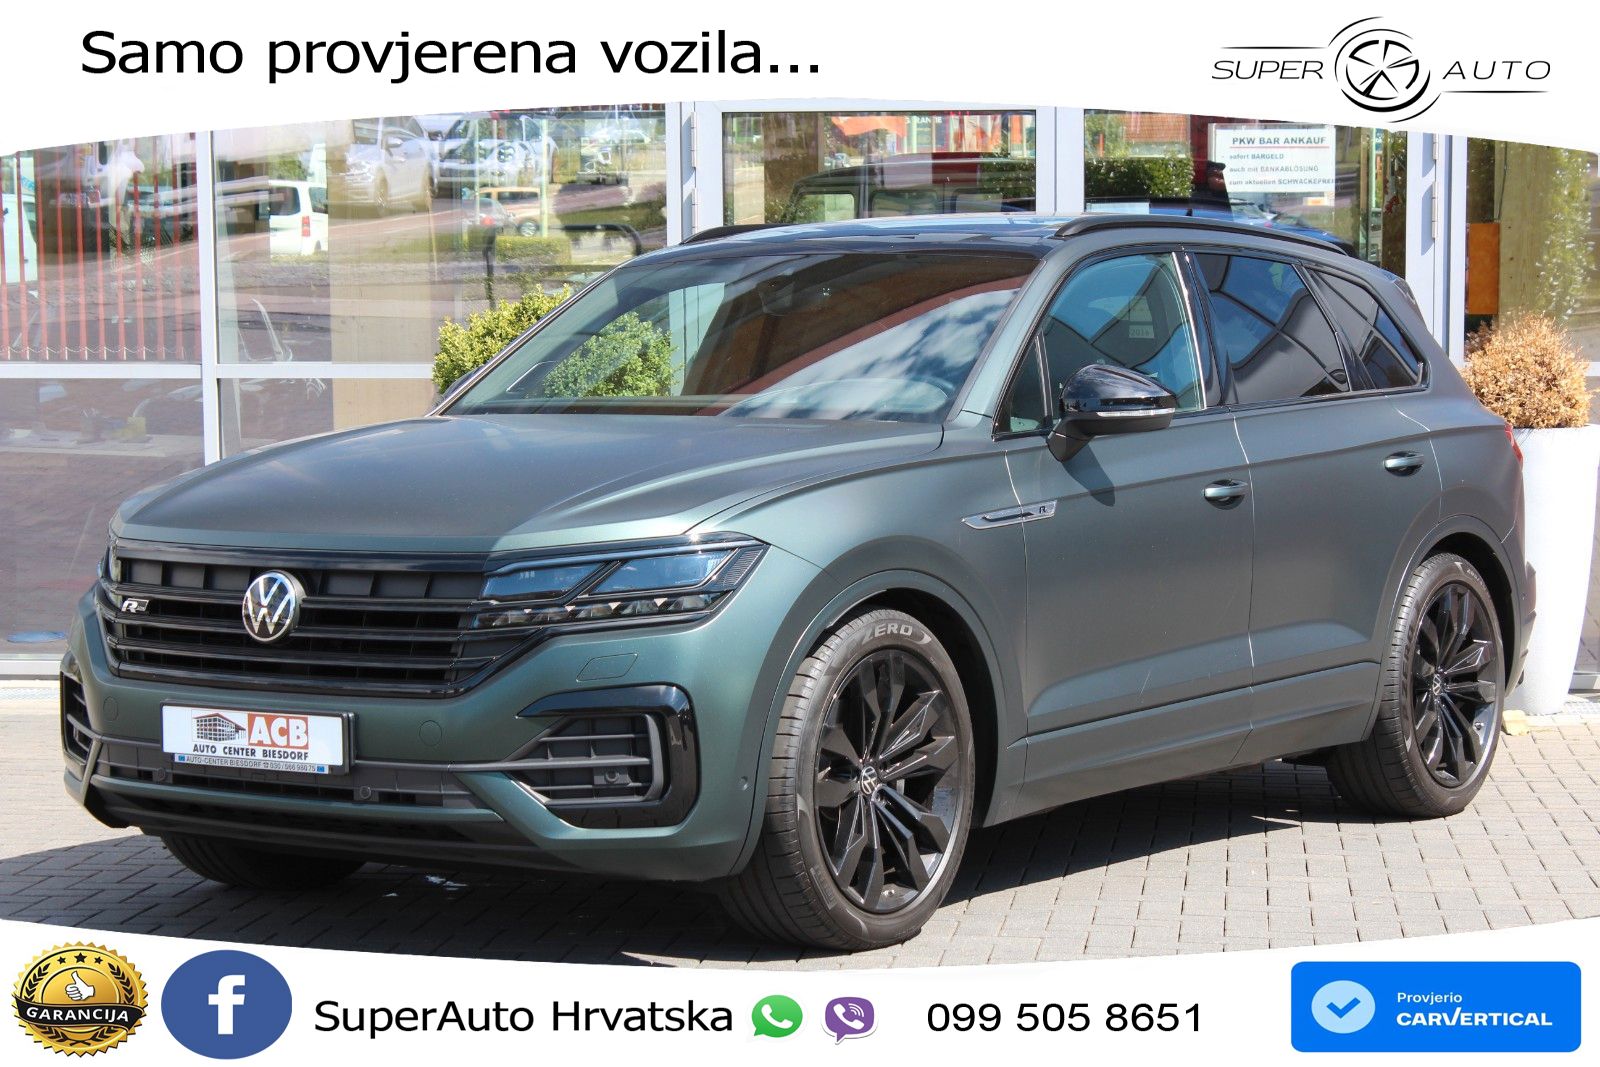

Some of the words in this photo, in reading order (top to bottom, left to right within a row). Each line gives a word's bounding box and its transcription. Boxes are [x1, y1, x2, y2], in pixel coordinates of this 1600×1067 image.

[1232, 136, 1256, 145] PKW
[1259, 136, 1280, 145] BAR
[1283, 136, 1327, 145] ANKAUF
[248, 715, 308, 748] ACB
[193, 743, 217, 754] AUTO
[222, 745, 256, 758] CENTER
[262, 748, 309, 761] BIESDORF
